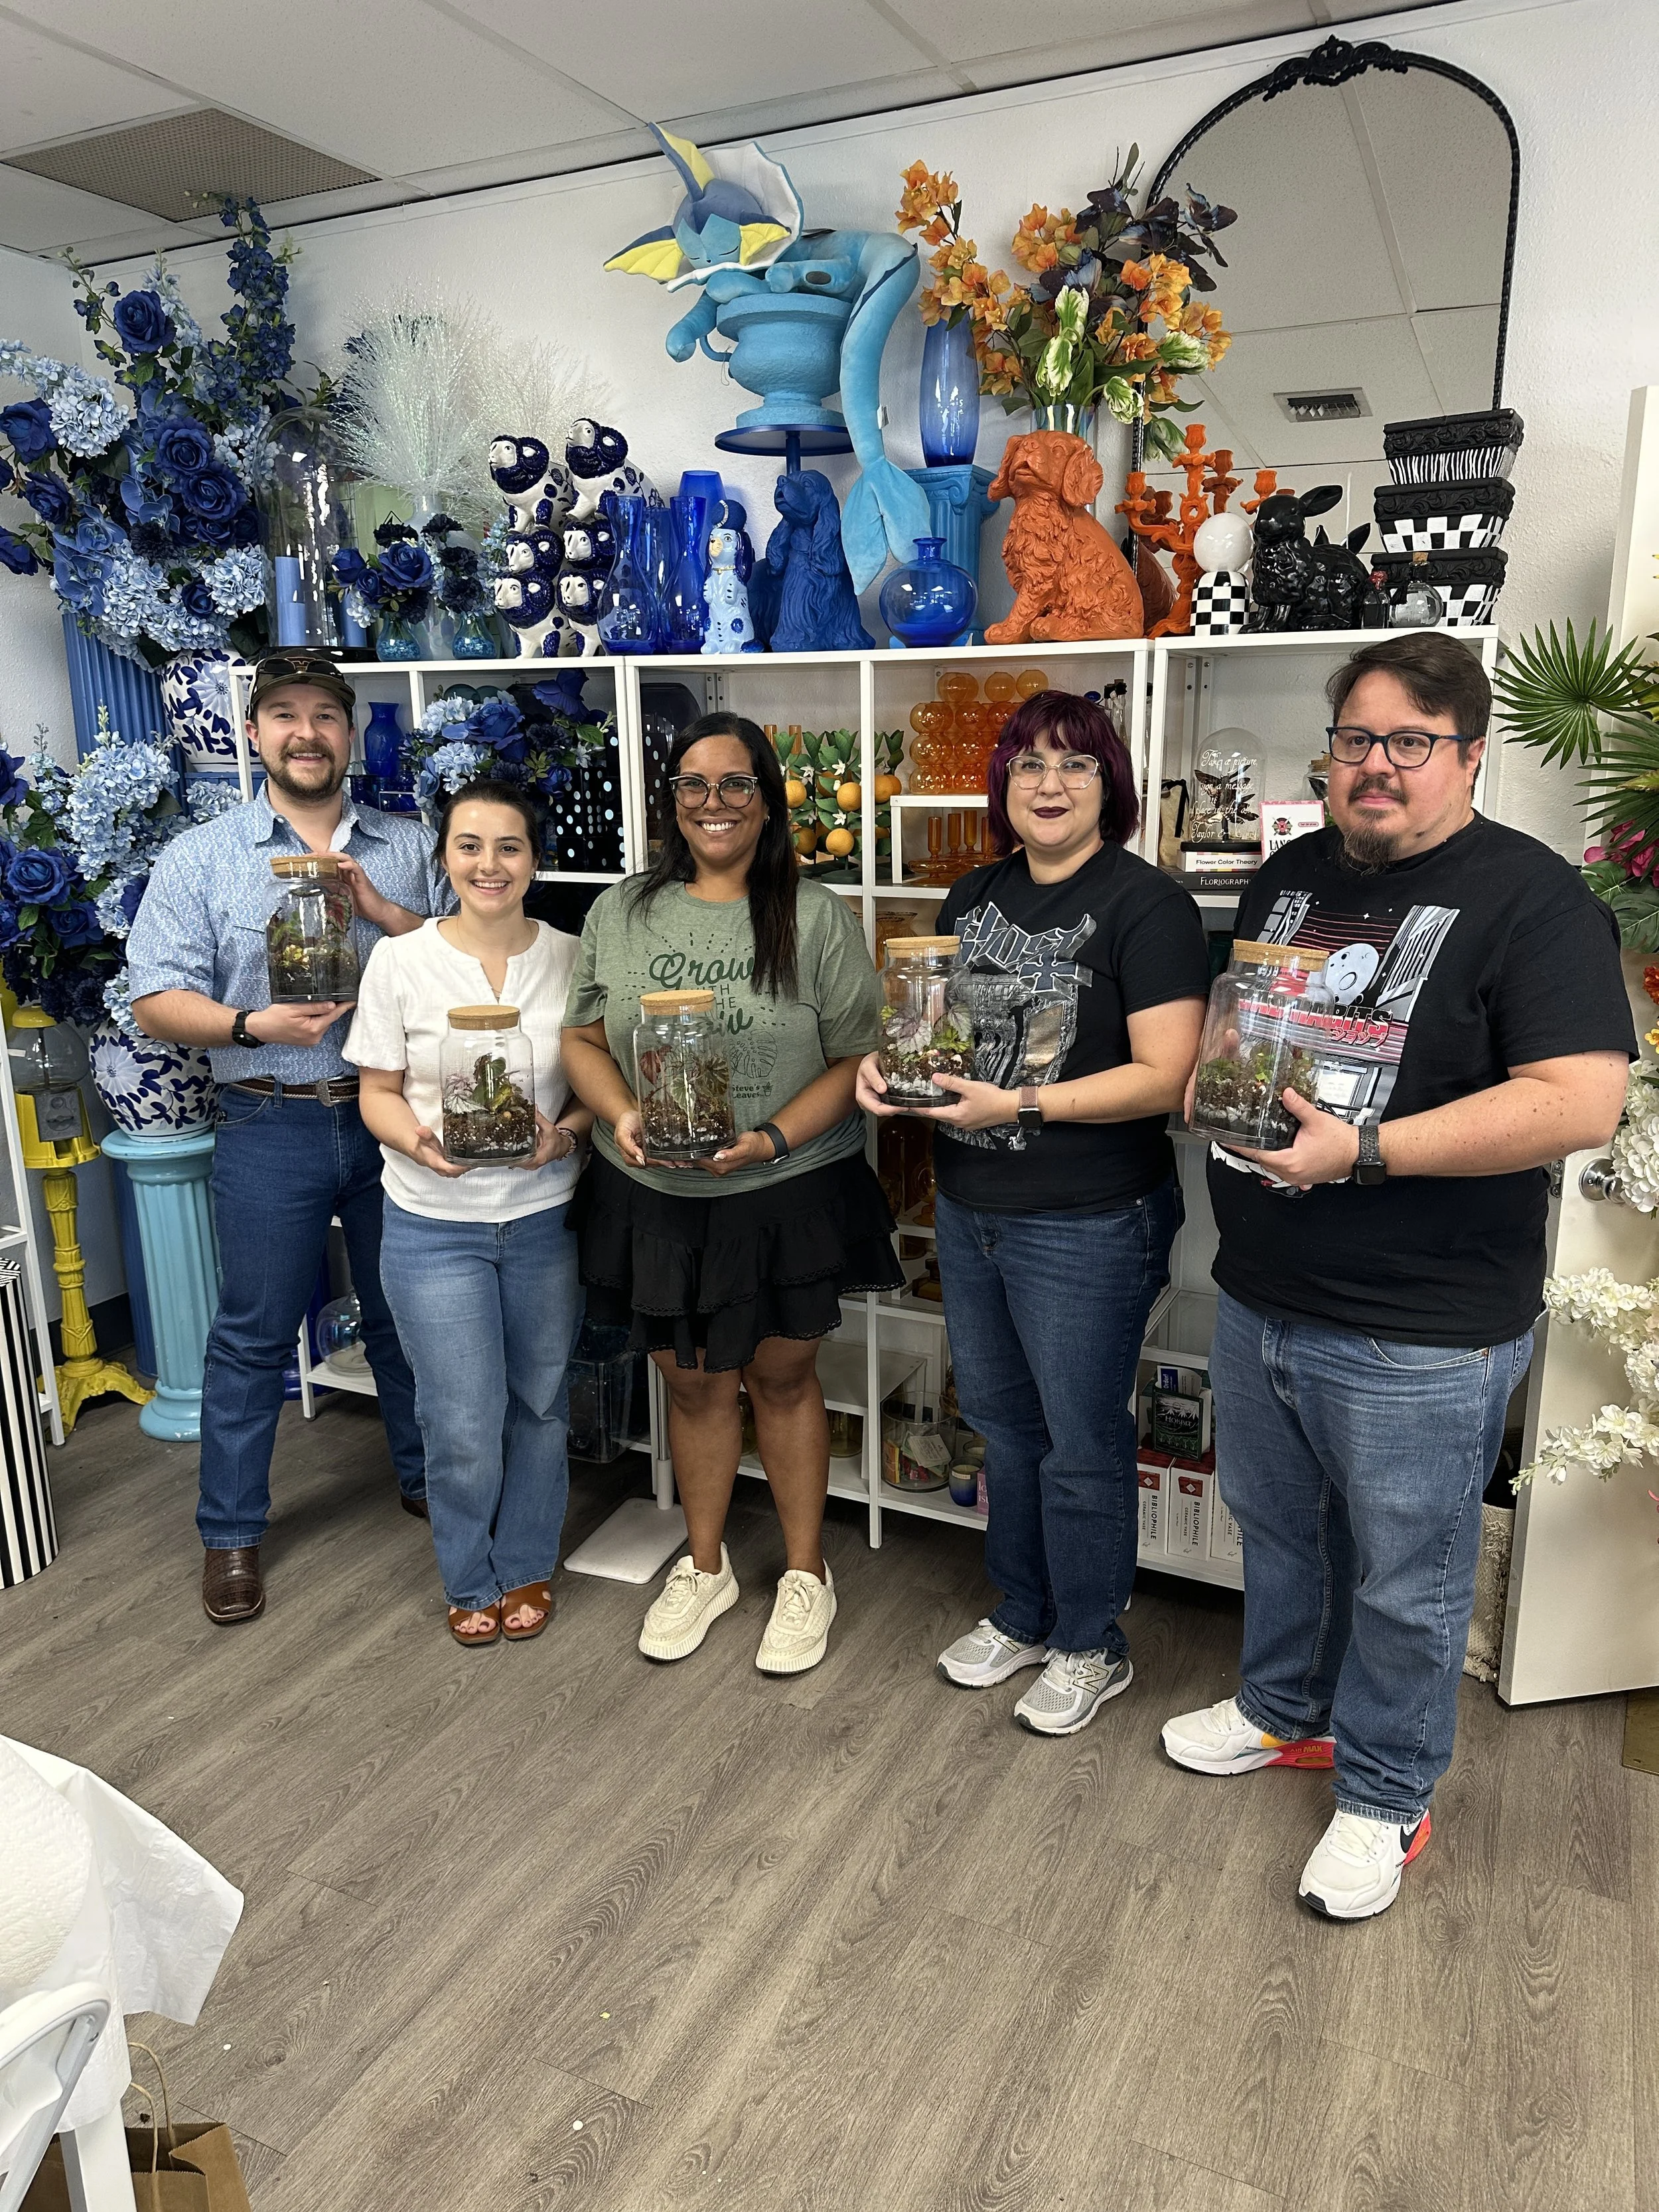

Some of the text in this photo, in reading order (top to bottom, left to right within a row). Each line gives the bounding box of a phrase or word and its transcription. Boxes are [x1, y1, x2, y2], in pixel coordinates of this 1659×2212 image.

[1192, 822, 1215, 843] Taylor
[1200, 877, 1251, 886] FLORIOGRAPH
[649, 952, 755, 990] Grow
[1165, 1415, 1192, 1427] HOBBIT
[1192, 1501, 1200, 1546] BIBLIOPHILE
